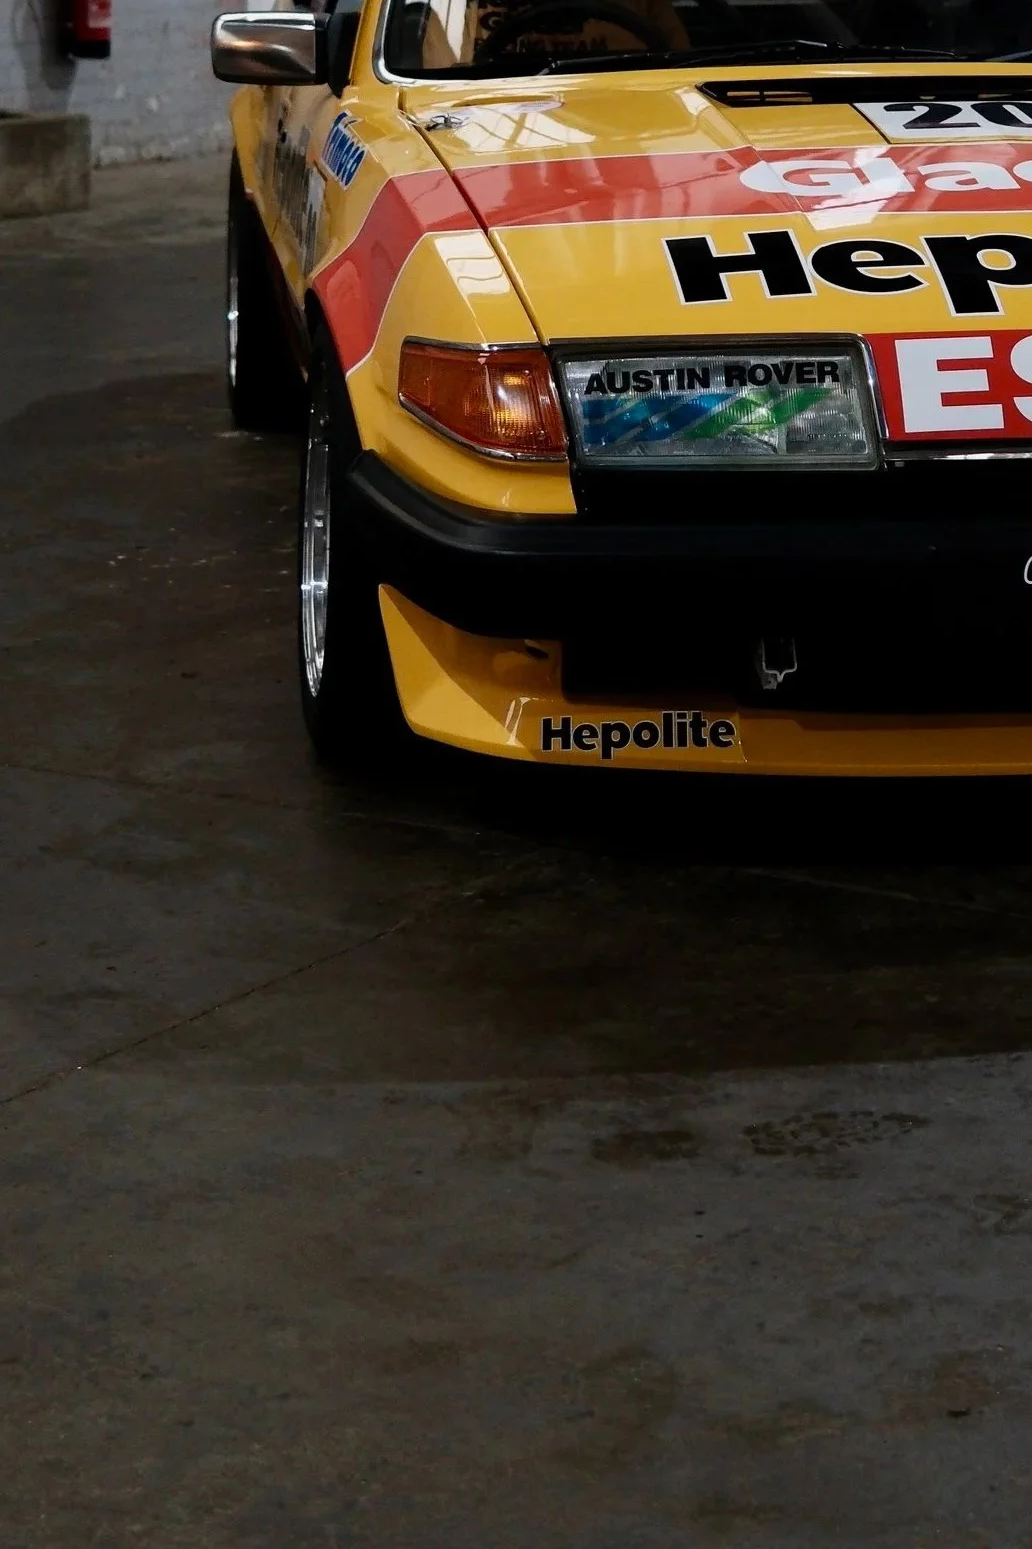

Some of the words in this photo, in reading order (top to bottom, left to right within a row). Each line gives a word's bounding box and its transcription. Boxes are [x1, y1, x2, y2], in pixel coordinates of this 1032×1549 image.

[584, 366, 711, 395] AUSTIN
[724, 361, 840, 387] ROVER
[541, 710, 736, 761] Hepolite
